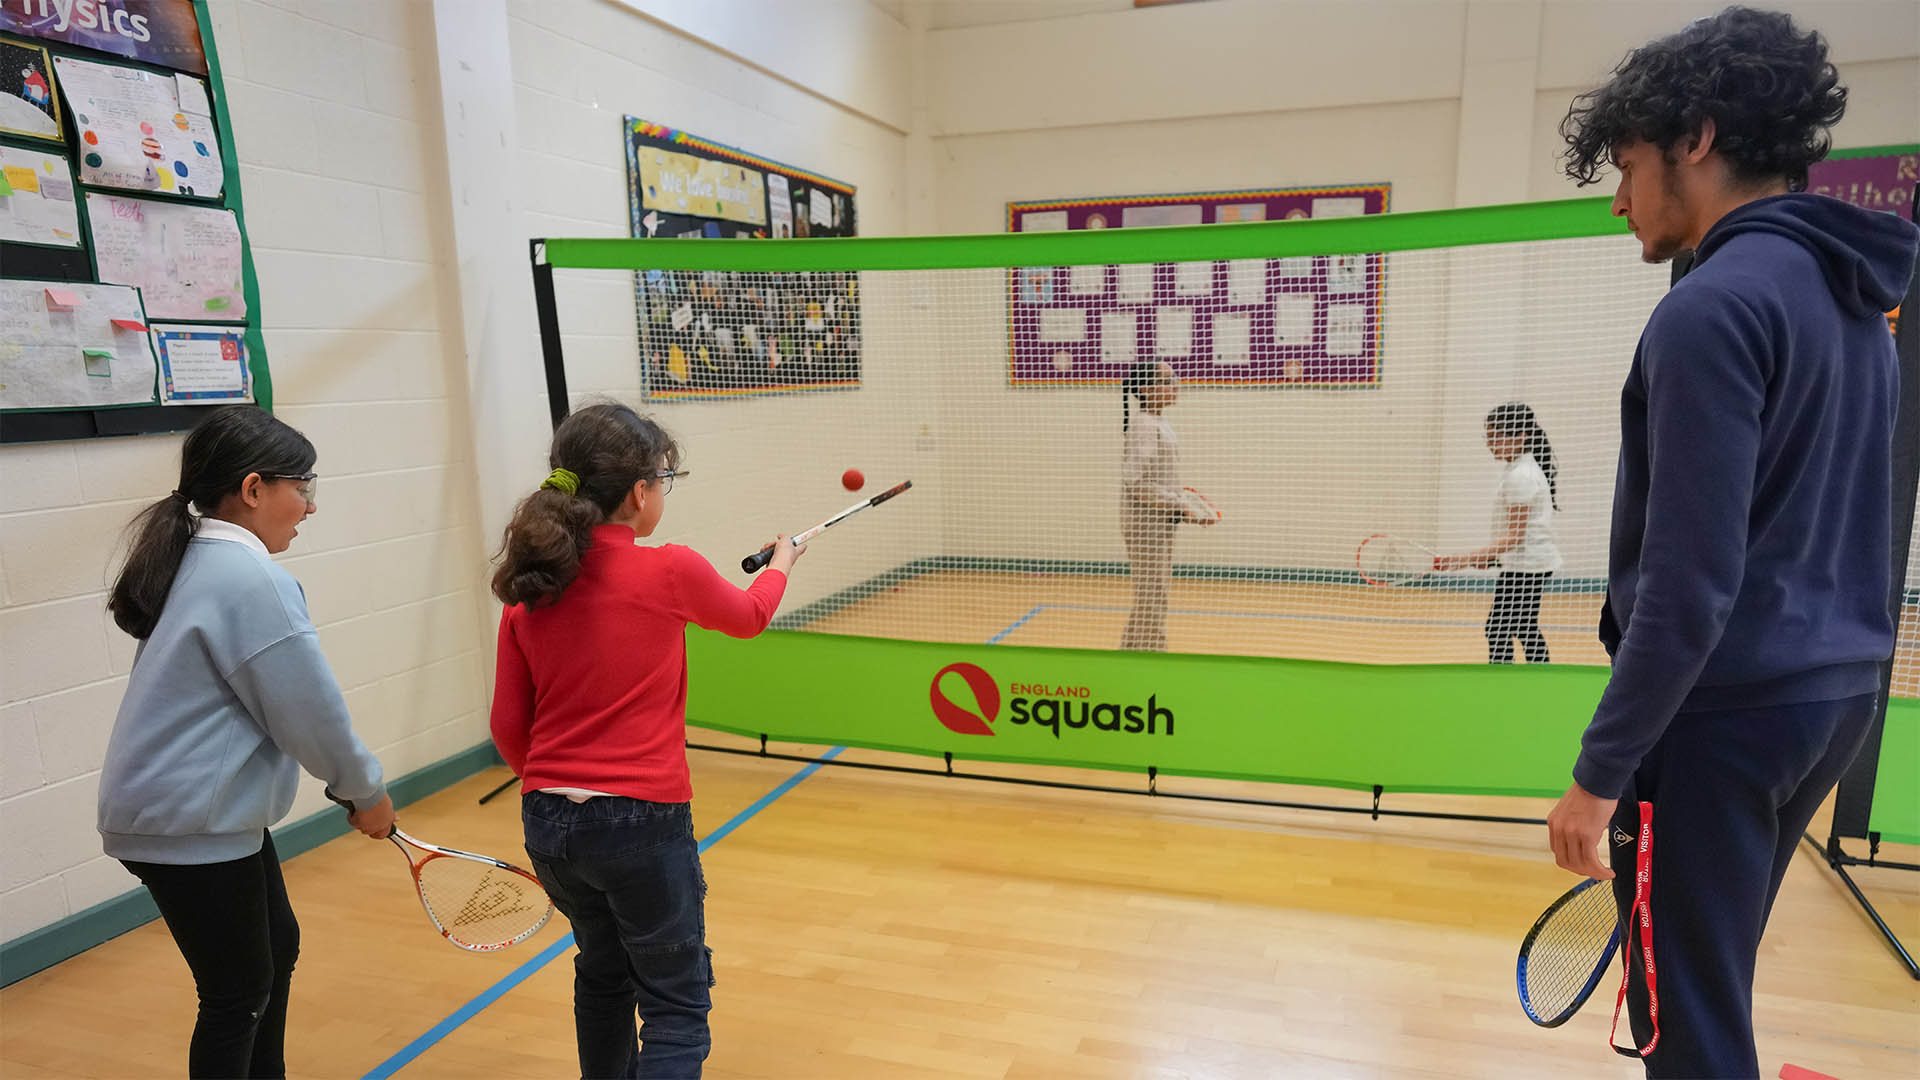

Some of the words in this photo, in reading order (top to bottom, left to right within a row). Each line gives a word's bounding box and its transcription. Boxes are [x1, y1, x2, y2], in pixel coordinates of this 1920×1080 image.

[0, 0, 151, 42] ysics
[1010, 683, 1090, 698] ENGLAND
[1010, 693, 1174, 740] squash
[1640, 824, 1649, 853] VISITOR
[1640, 901, 1649, 928] VISITOR
[1644, 946, 1654, 974] VISITOR
